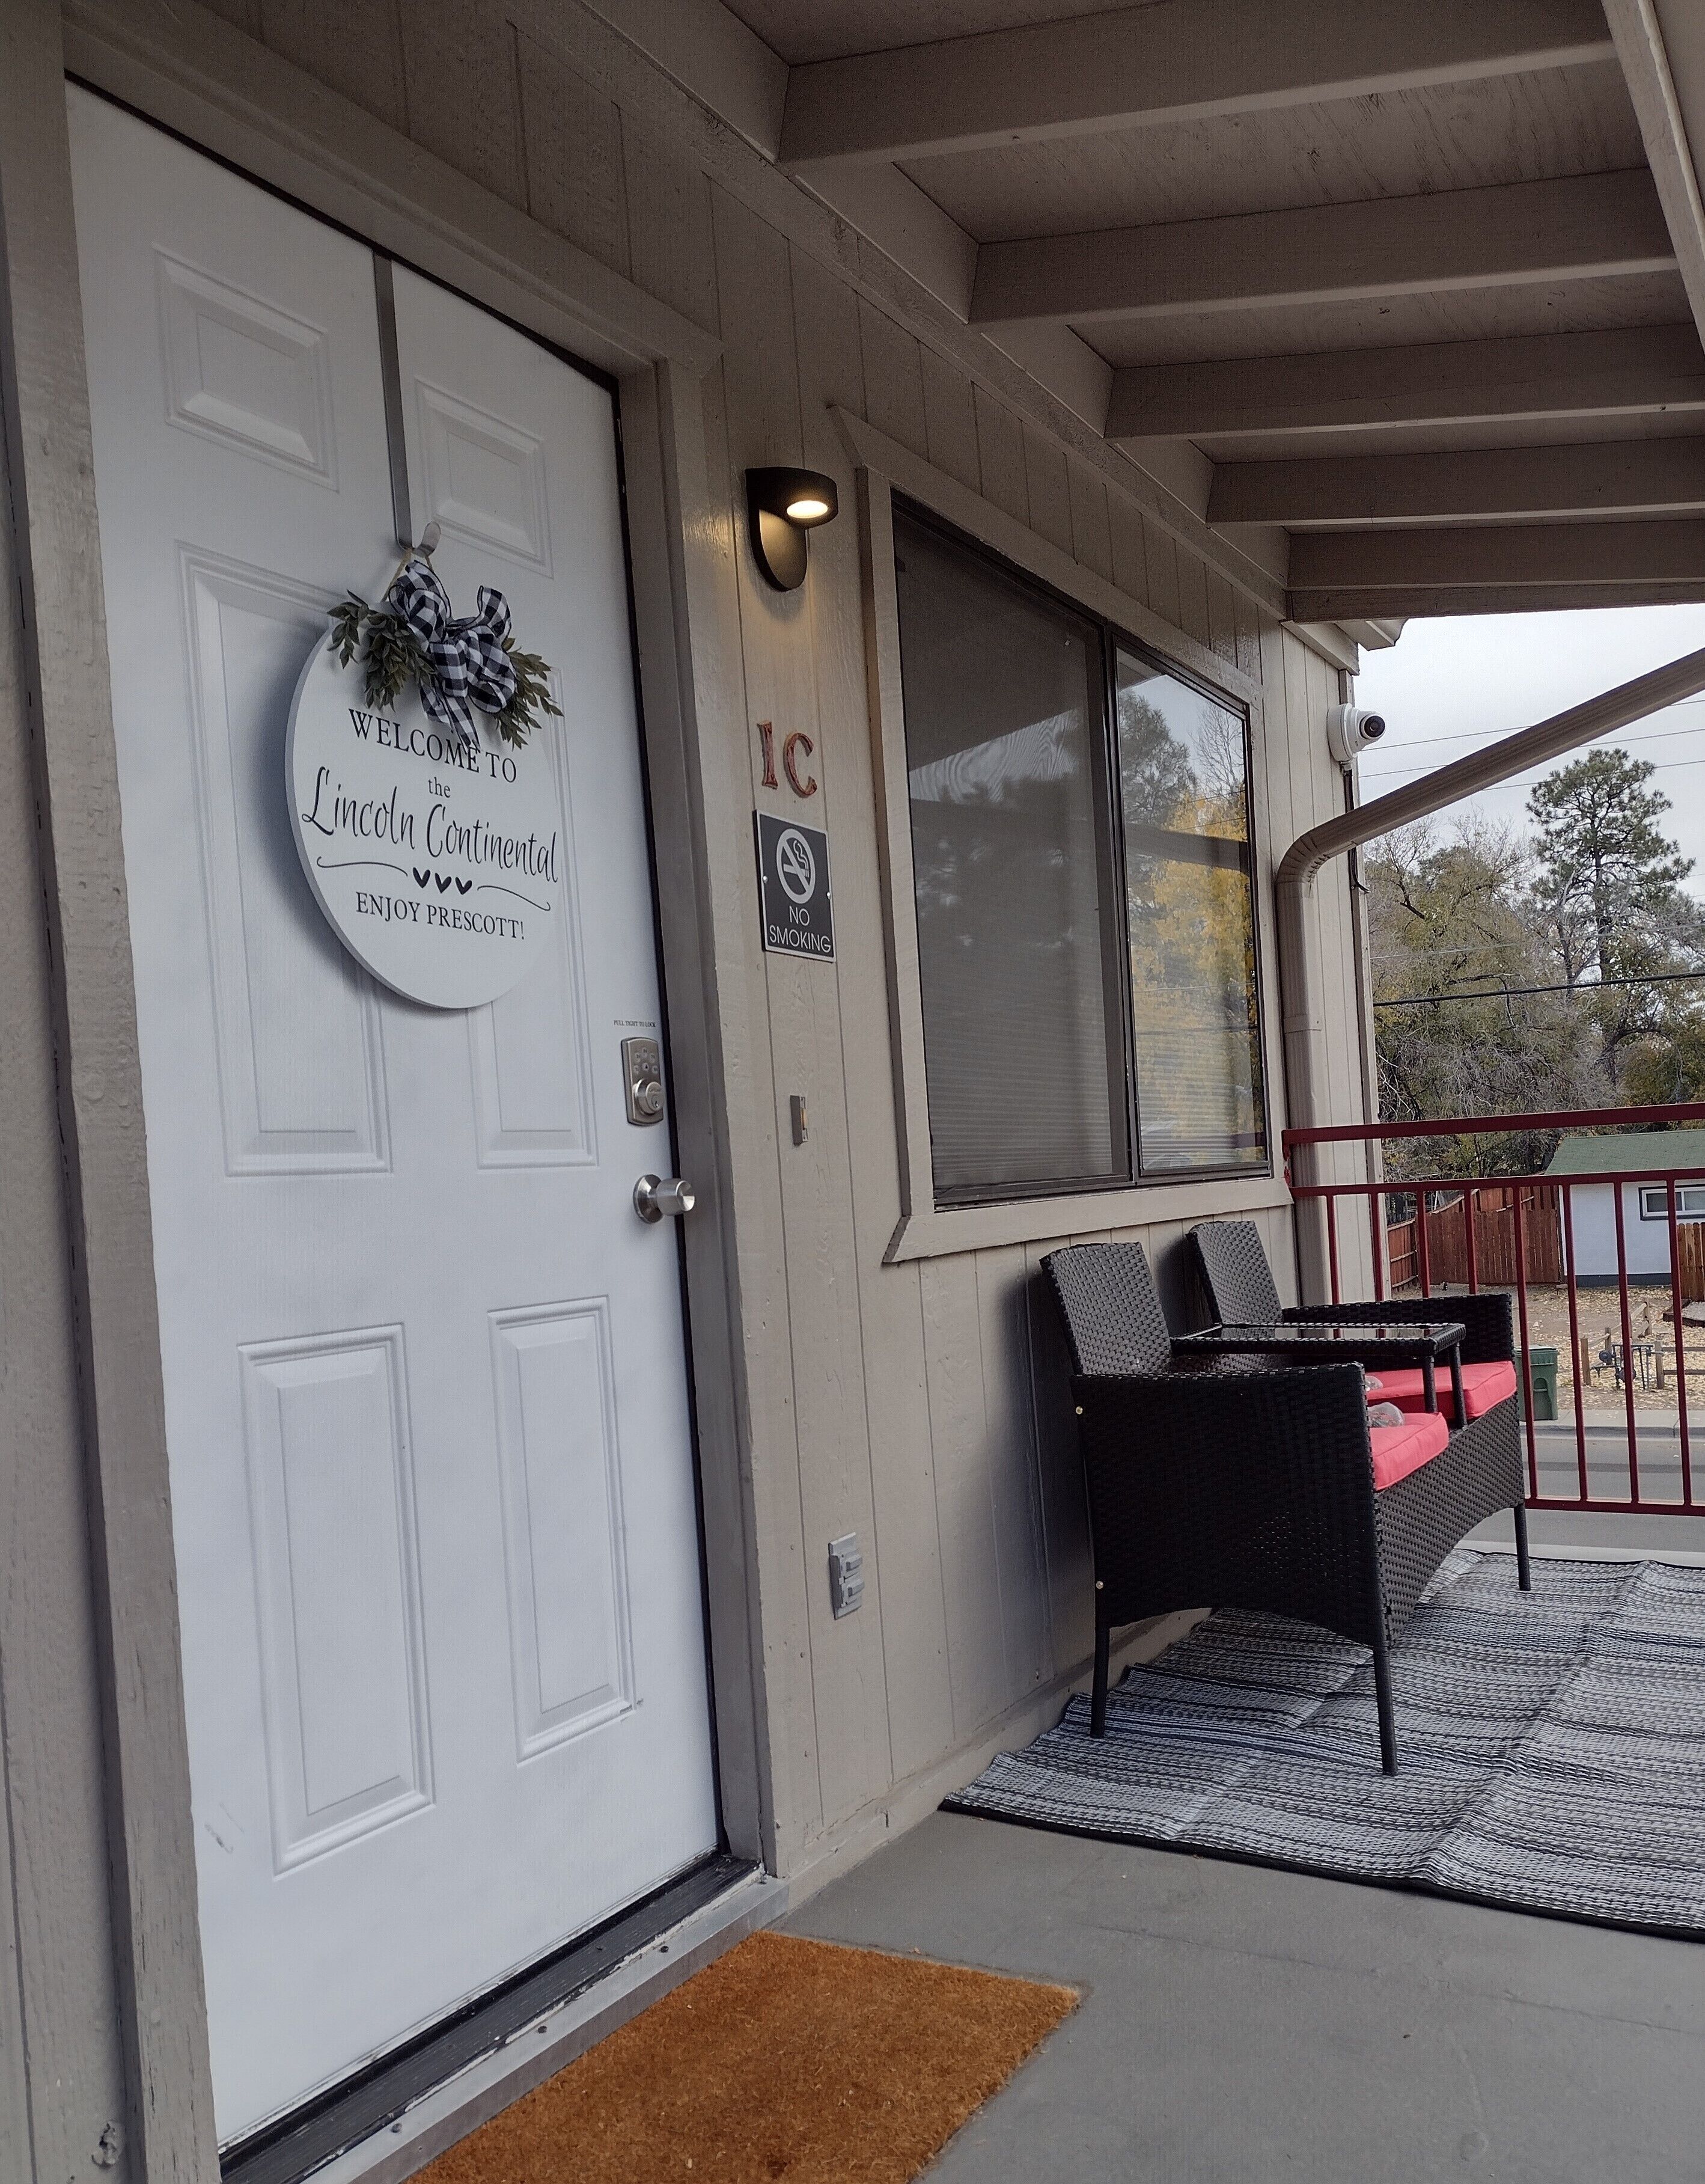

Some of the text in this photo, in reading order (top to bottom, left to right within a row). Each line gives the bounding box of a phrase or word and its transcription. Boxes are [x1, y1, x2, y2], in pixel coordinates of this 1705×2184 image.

[349, 708, 517, 783] WELCOME TO
[427, 777, 451, 798] the
[302, 766, 558, 883] Lincoln Continental
[356, 892, 525, 940] ENJOY PRESCOTT!
[788, 905, 811, 926] NO
[769, 925, 832, 953] SMOKING
